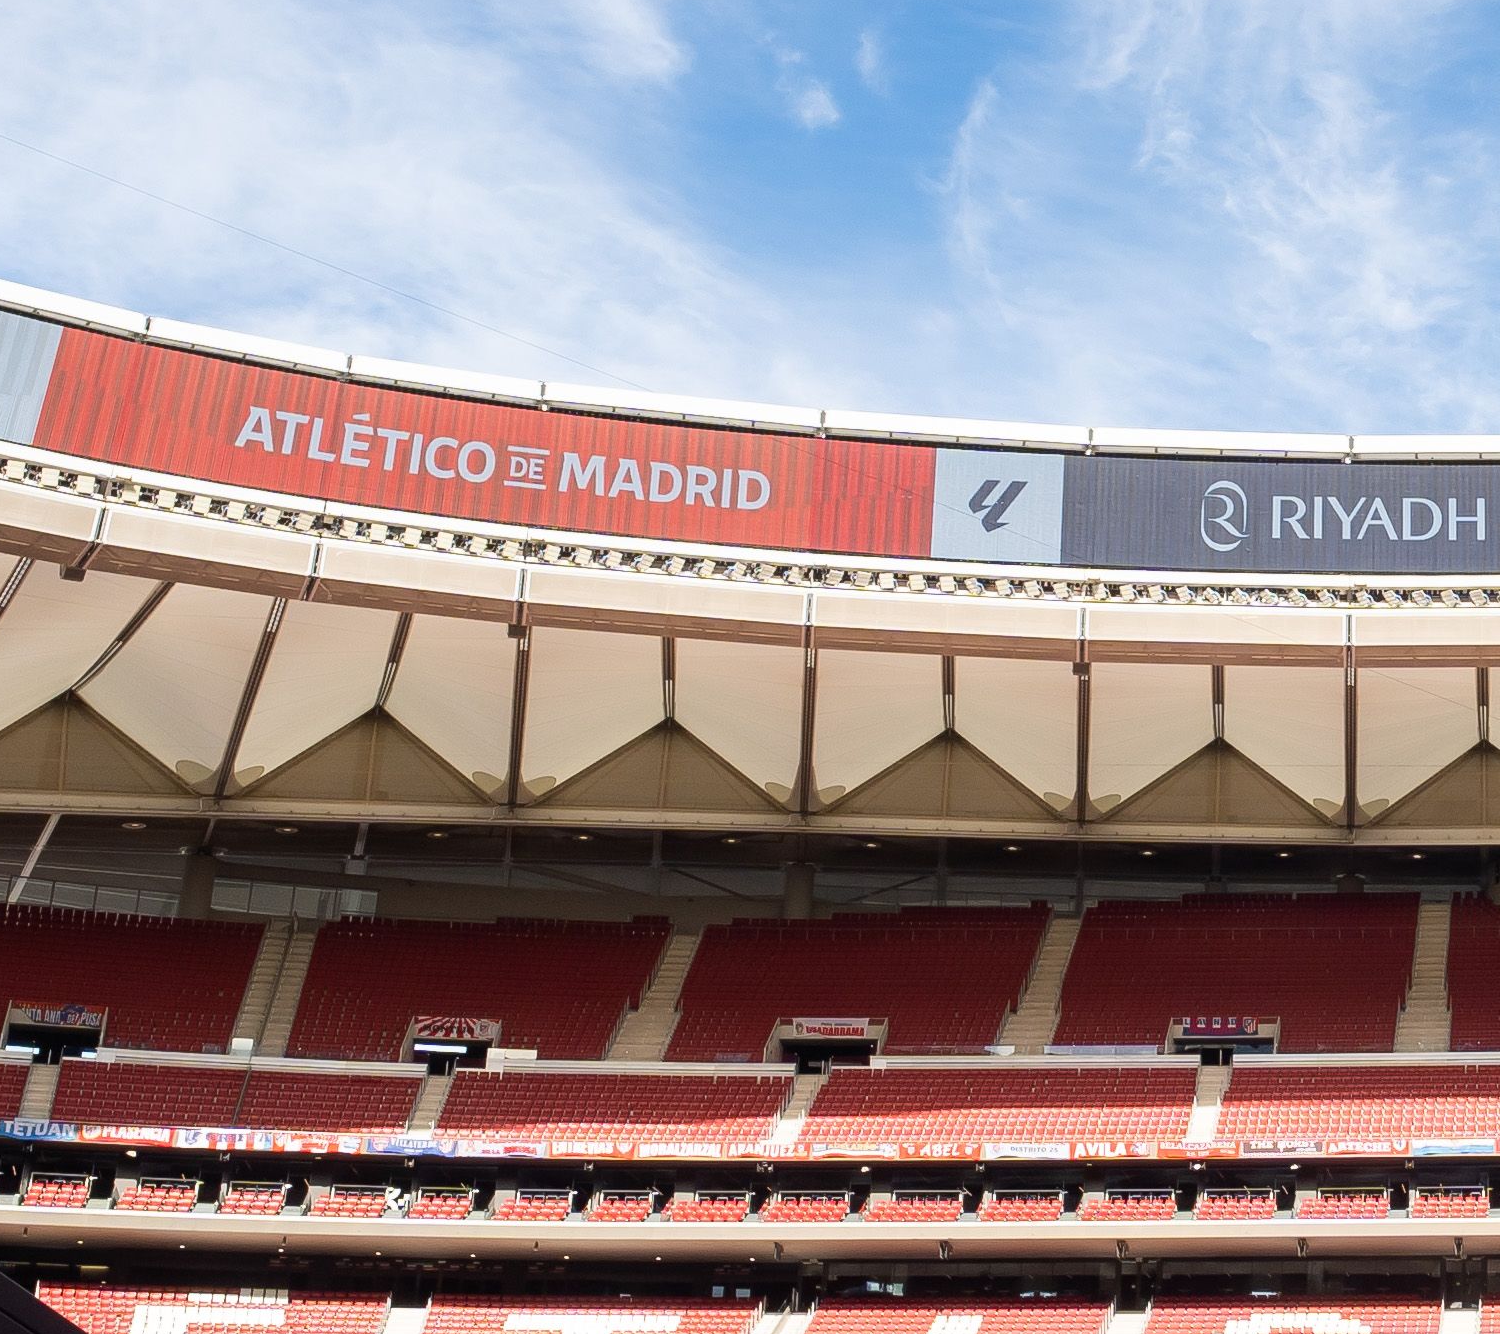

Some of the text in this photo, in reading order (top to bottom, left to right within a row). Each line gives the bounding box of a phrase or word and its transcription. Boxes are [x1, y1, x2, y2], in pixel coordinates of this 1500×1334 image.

[233, 405, 773, 512] ATLÉTICO DE MADRID
[1271, 494, 1487, 542] RIYADH
[3, 1119, 77, 1139] TETUAN
